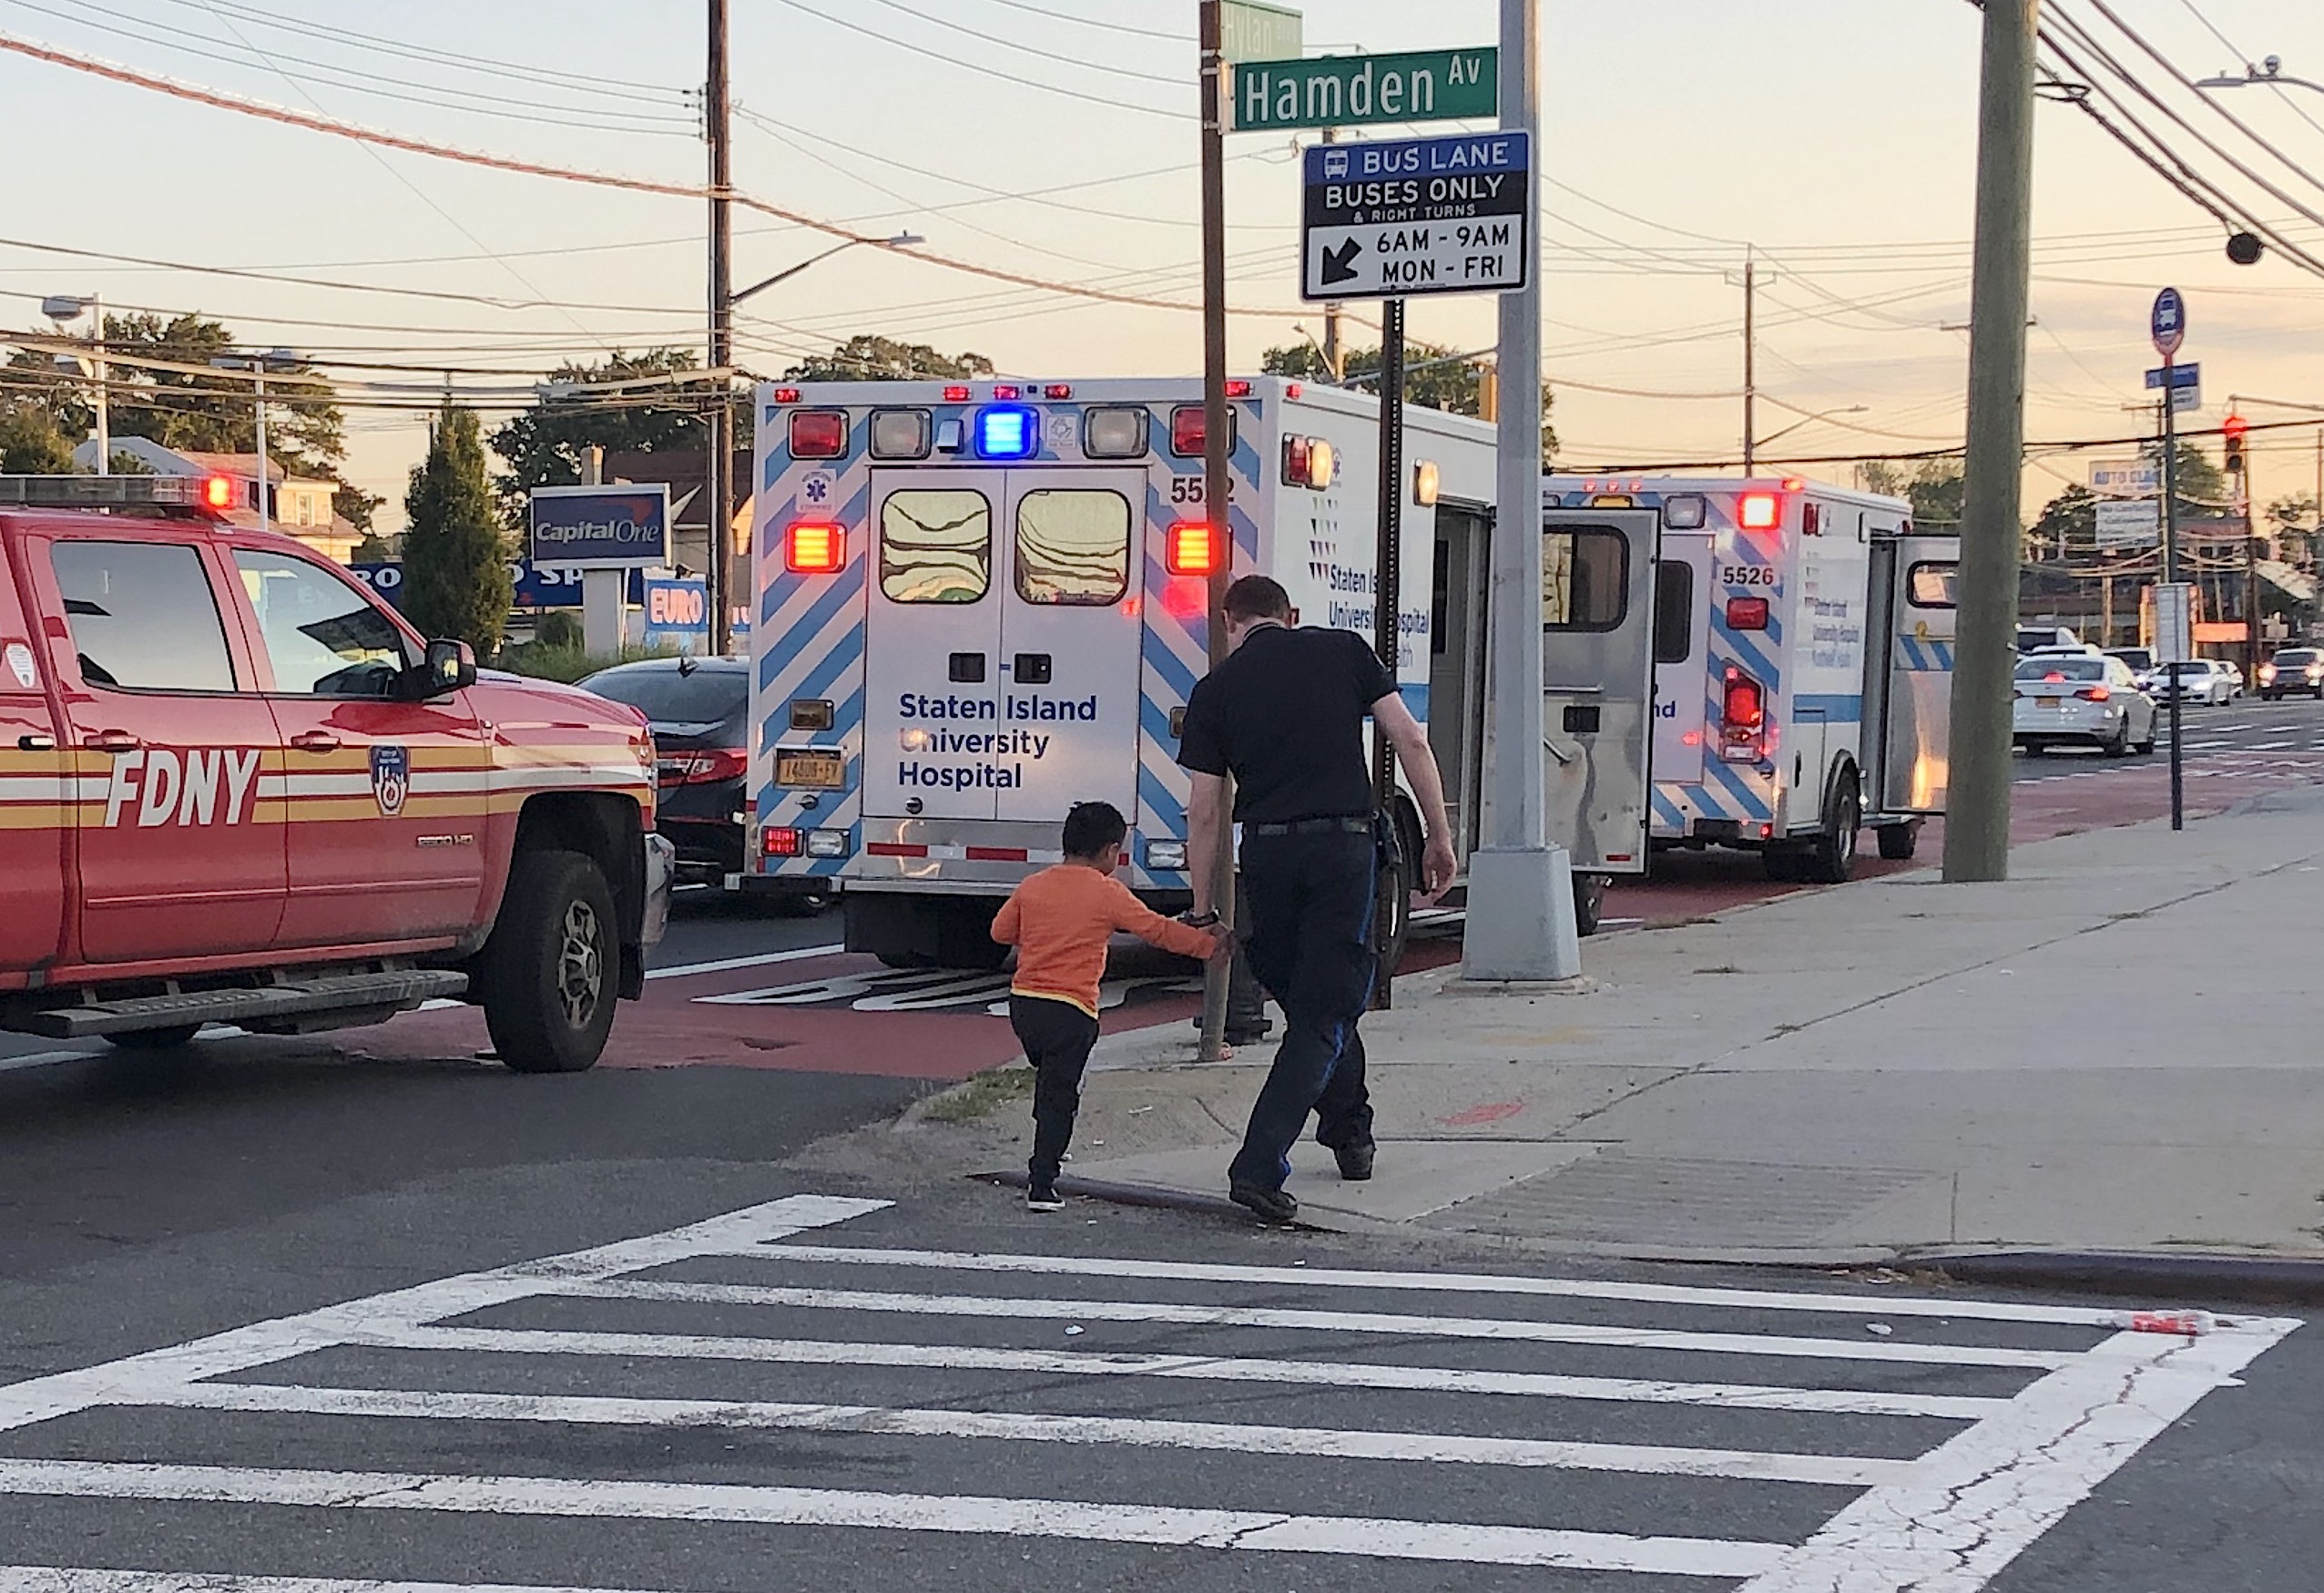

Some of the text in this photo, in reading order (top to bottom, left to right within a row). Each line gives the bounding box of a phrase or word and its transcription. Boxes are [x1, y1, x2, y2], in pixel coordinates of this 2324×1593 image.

[1225, 4, 1271, 61] Hylan
[1246, 61, 1433, 121] Hamden
[1363, 142, 1509, 174] BUS LANE
[1326, 174, 1504, 209] BUSES ONLY
[1353, 203, 1476, 223] & RIGHT TURNS
[1377, 229, 1429, 252] 6AM
[1457, 223, 1509, 247] 9AM
[1382, 259, 1435, 282] MON
[1464, 254, 1503, 278] FRI
[1171, 477, 1234, 504] 55
[1330, 564, 1366, 593] Staten
[1723, 566, 1773, 585] 5526
[650, 587, 703, 625] EURO
[1330, 600, 1430, 638] Universi ospital
[899, 693, 1096, 720] Staten Island
[900, 727, 1050, 760] University
[105, 750, 260, 828] FDNY
[899, 761, 1022, 791] Hospital
